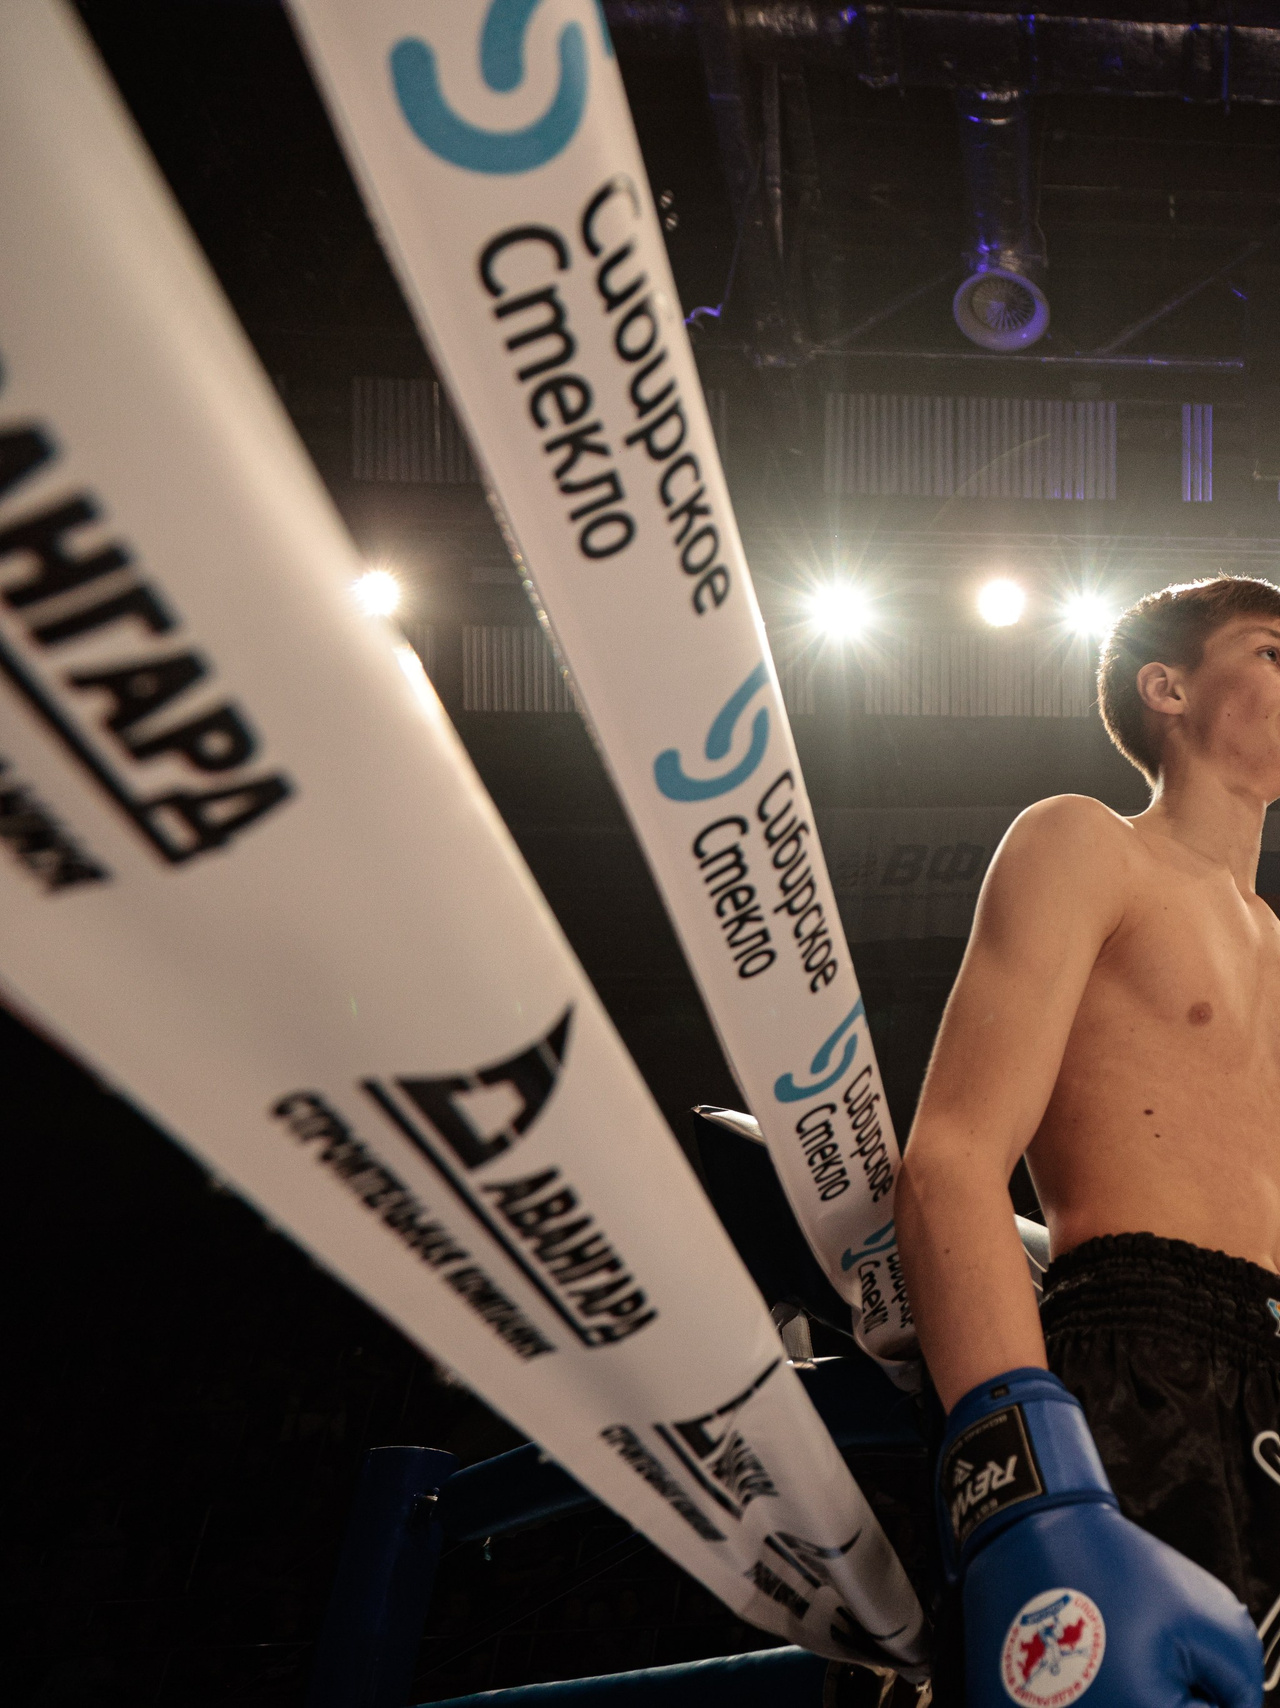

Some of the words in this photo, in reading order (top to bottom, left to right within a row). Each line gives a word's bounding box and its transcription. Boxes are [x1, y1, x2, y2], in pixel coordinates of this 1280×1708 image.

[477, 224, 637, 562] Стекло
[692, 815, 777, 980] Стекло
[757, 768, 838, 994] Сибирское
[795, 1102, 851, 1203] Стекло
[843, 1064, 895, 1203] Сибирское
